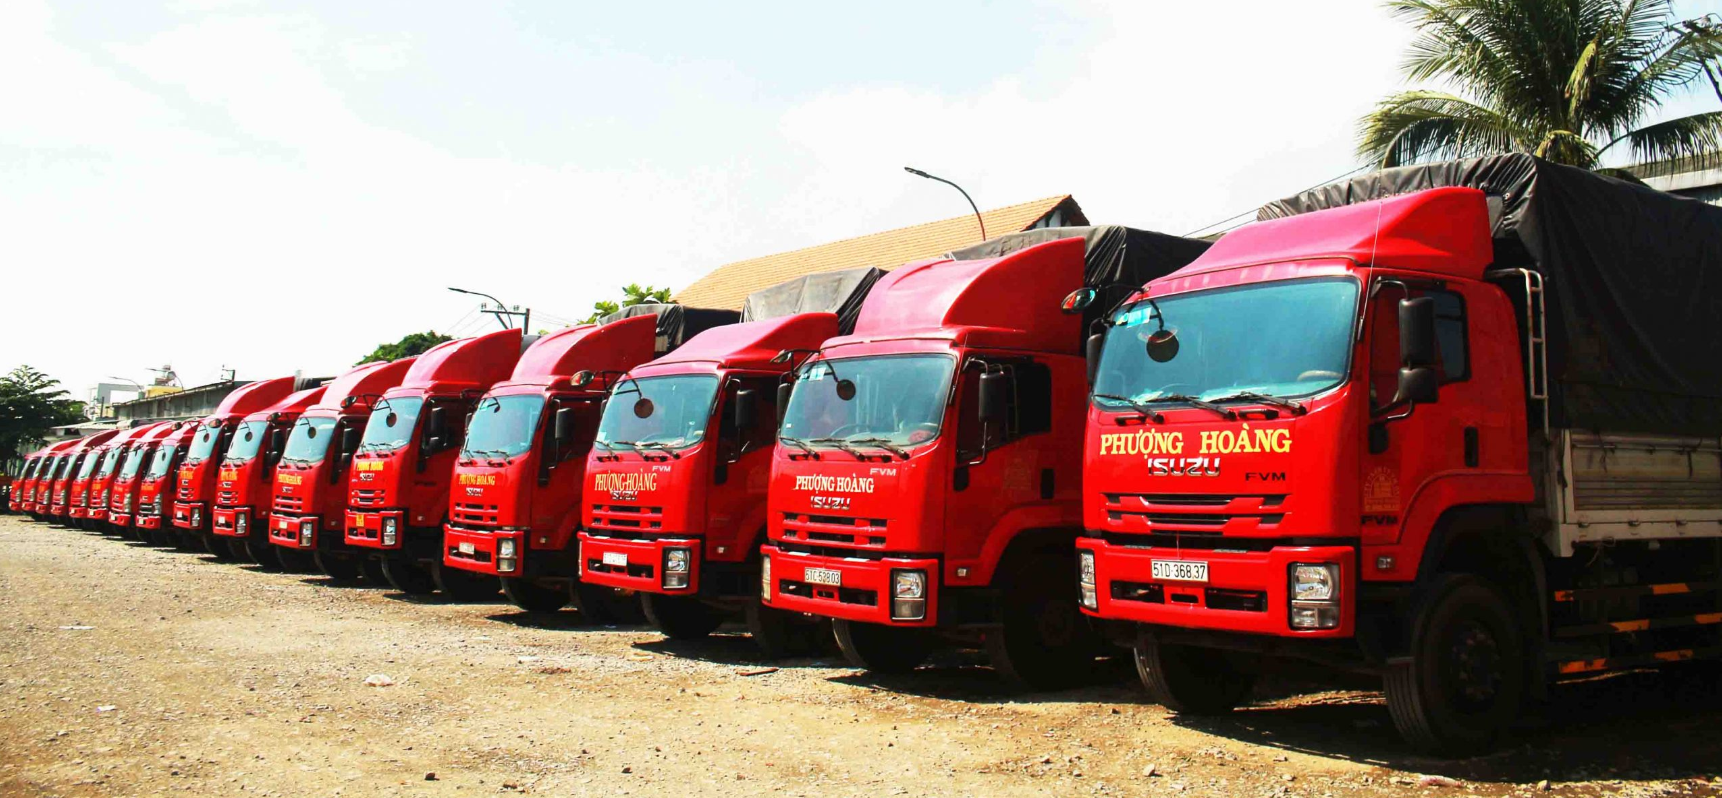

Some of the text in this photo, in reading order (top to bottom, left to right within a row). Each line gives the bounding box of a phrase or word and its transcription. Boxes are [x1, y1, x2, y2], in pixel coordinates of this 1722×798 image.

[1100, 423, 1292, 460] PHƯỢNG HOÀNG
[870, 467, 896, 476] FVM
[1147, 457, 1220, 476] ISUZU
[794, 472, 874, 494] PHƯỢNG HOÀNG
[1245, 472, 1286, 481] FVM
[810, 496, 850, 510] ISUZU
